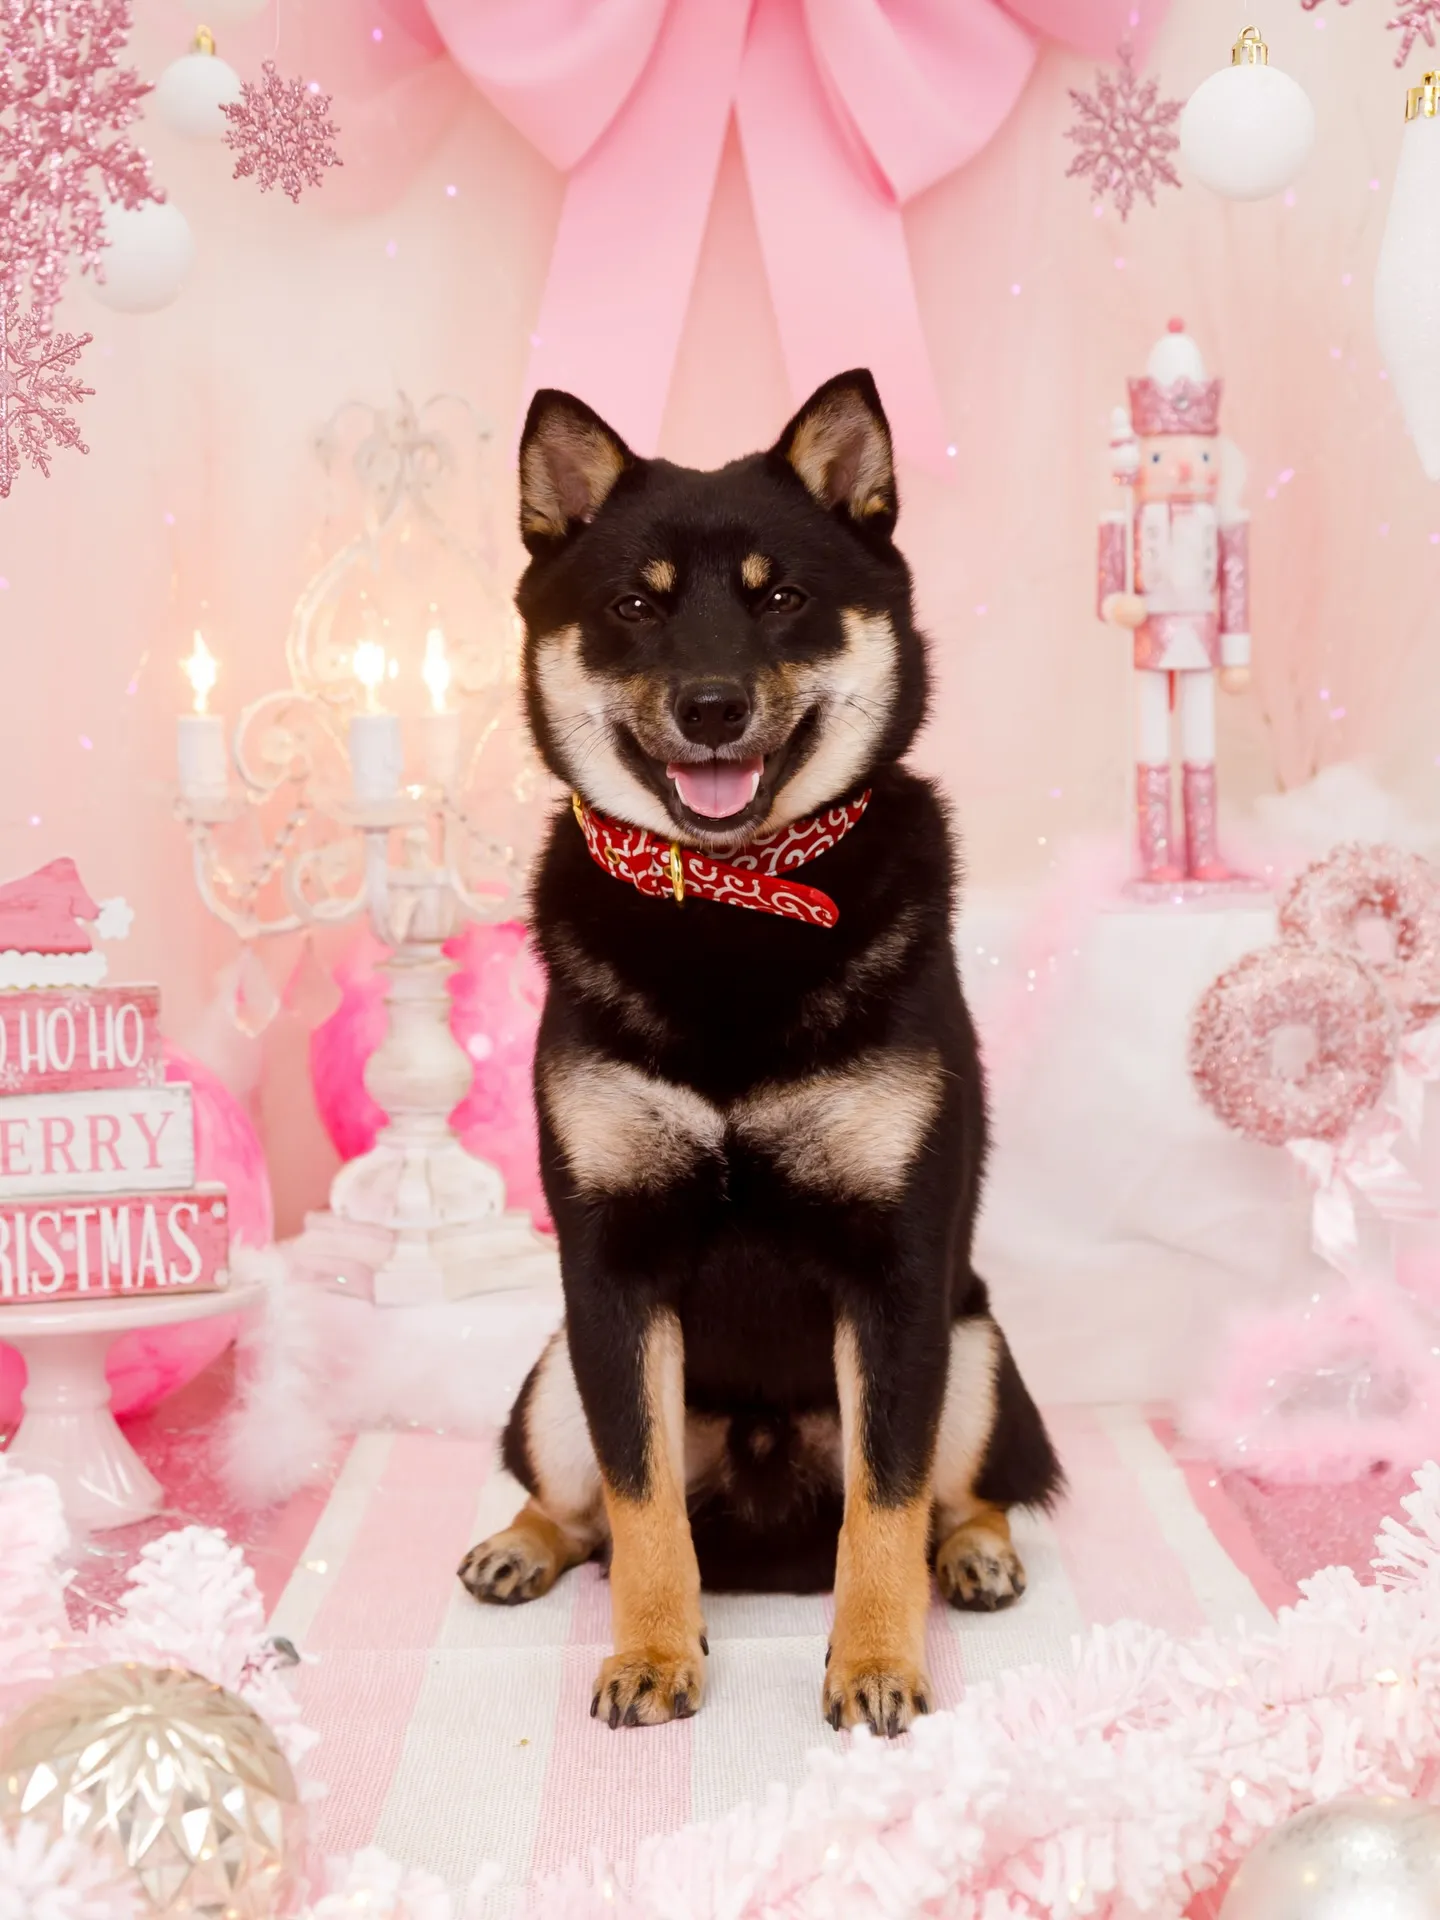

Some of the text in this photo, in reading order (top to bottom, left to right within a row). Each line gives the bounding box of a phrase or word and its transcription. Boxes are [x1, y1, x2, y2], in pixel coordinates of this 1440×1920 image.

[20, 1007, 76, 1073] HO
[88, 1003, 144, 1070] HO
[0, 1111, 174, 1176] ERRY
